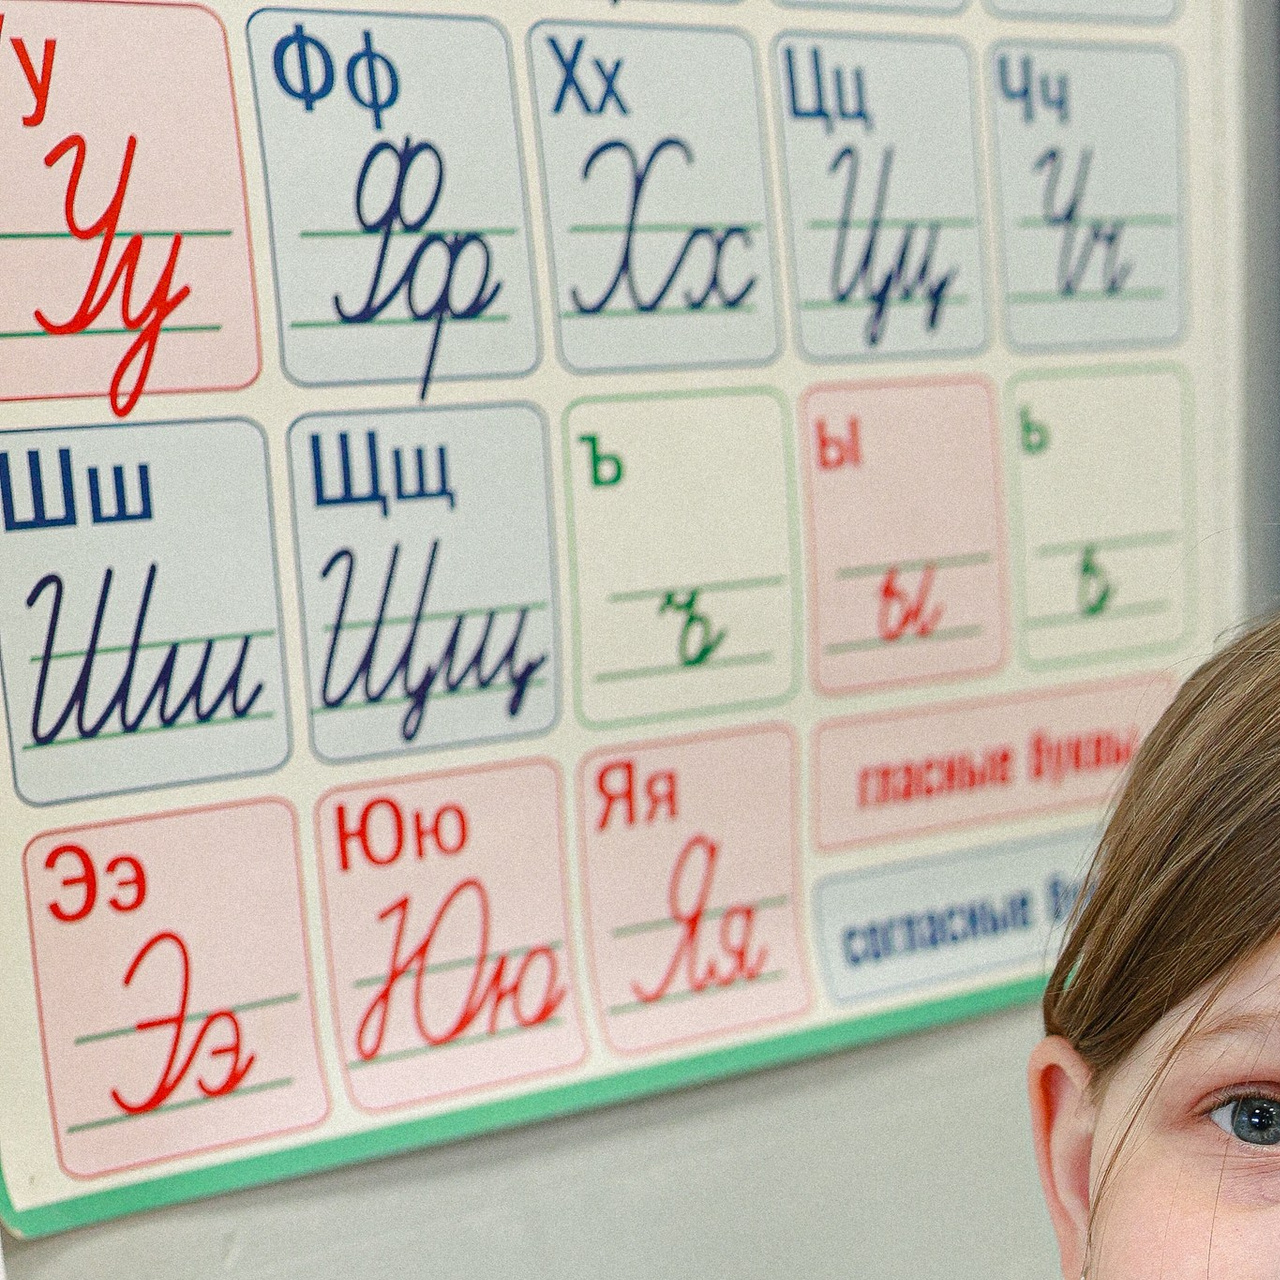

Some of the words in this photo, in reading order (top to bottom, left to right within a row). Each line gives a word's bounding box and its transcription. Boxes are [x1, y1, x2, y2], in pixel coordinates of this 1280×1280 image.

[273, 24, 400, 129] Фф
[547, 37, 629, 115] Хх
[786, 46, 873, 134] Цц
[999, 54, 1070, 123] Чч
[335, 136, 500, 400] Фф
[572, 139, 756, 315] Хх
[830, 145, 958, 346] Цц
[1036, 146, 1131, 296] Чч
[35, 134, 190, 416] Уу
[0, 447, 152, 531] Шш
[310, 430, 456, 518] Щщ
[26, 564, 263, 745] Шш
[321, 538, 547, 741] Щщ
[596, 760, 678, 831] Яя
[855, 743, 1014, 810] гласные
[44, 843, 147, 922] Ээ
[335, 797, 468, 872] Юю
[356, 877, 567, 1062] Юю
[631, 834, 769, 1004] Яя
[842, 890, 1030, 966] согласные
[111, 930, 255, 1116] Ээ
